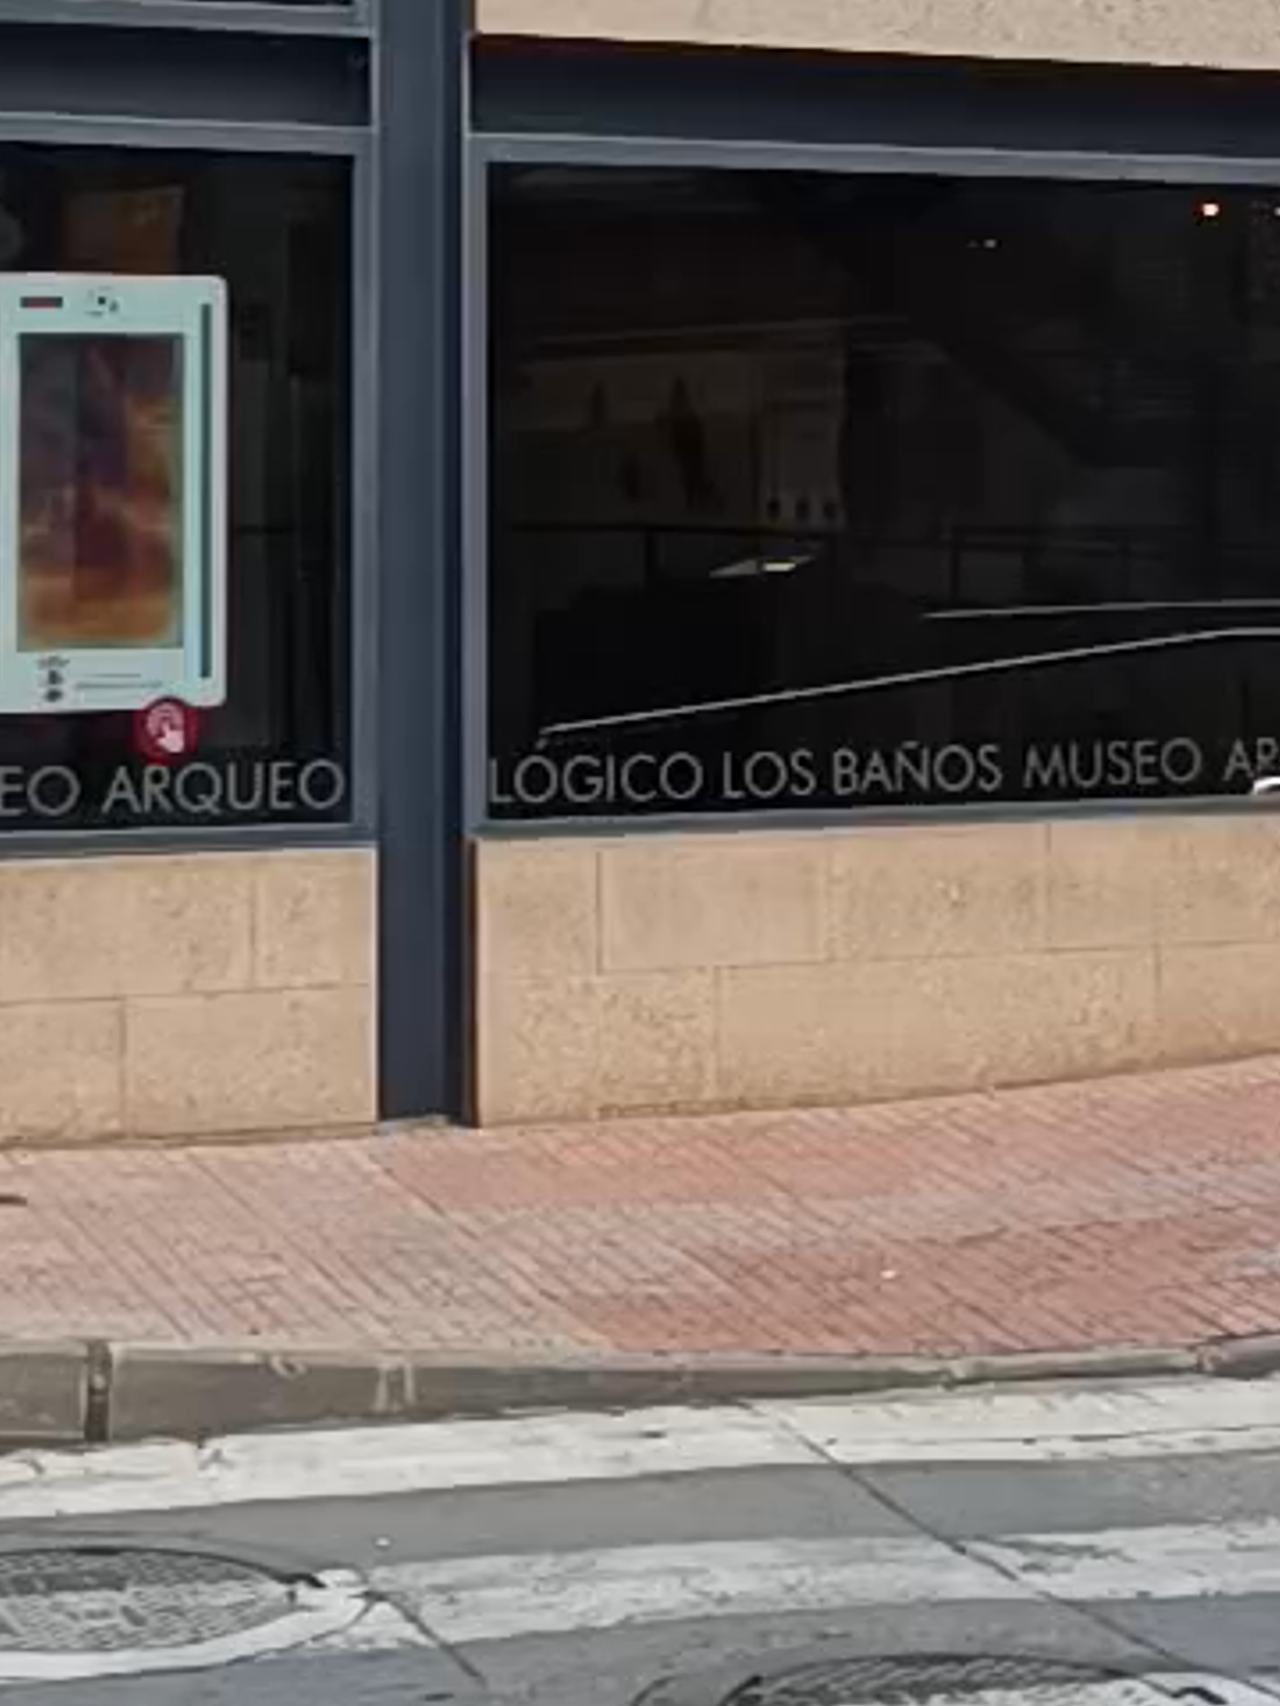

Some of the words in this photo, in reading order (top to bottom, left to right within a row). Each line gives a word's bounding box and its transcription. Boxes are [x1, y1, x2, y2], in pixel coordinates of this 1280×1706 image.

[100, 759, 345, 815] ARQUEO
[722, 748, 818, 799] LOS
[832, 740, 1003, 795] BAÑOS
[1023, 736, 1203, 789] MUSEO
